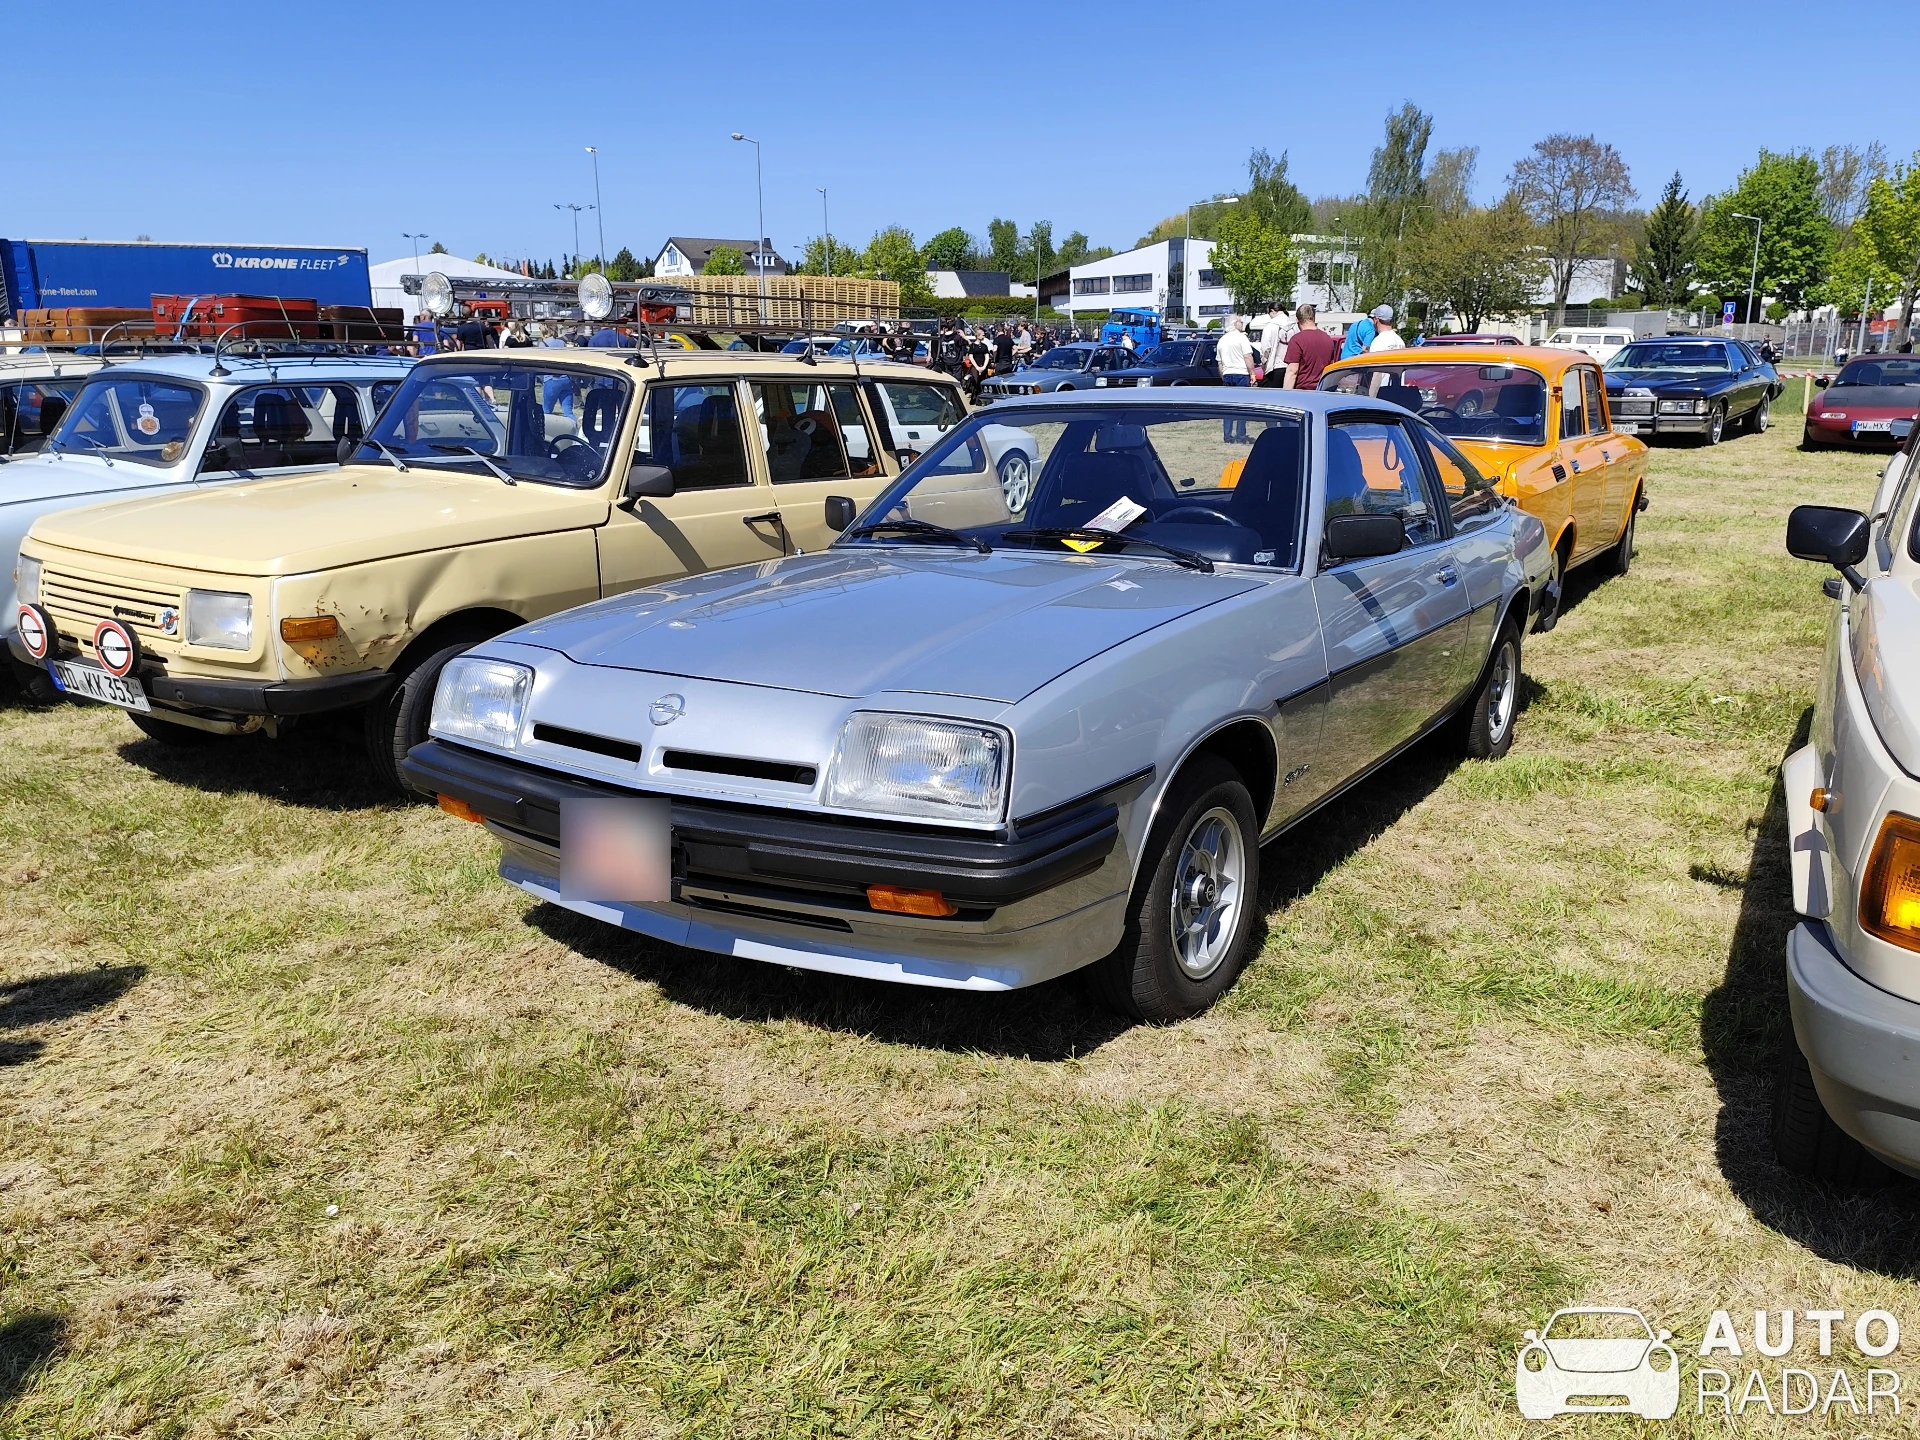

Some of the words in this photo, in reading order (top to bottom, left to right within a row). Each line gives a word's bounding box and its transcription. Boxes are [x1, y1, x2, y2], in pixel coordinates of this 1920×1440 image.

[234, 257, 298, 269] KRONE
[300, 258, 336, 270] FLEET
[1856, 422, 1868, 430] MW
[55, 664, 80, 692] DD
[83, 671, 107, 698] KK
[104, 675, 135, 705] 353
